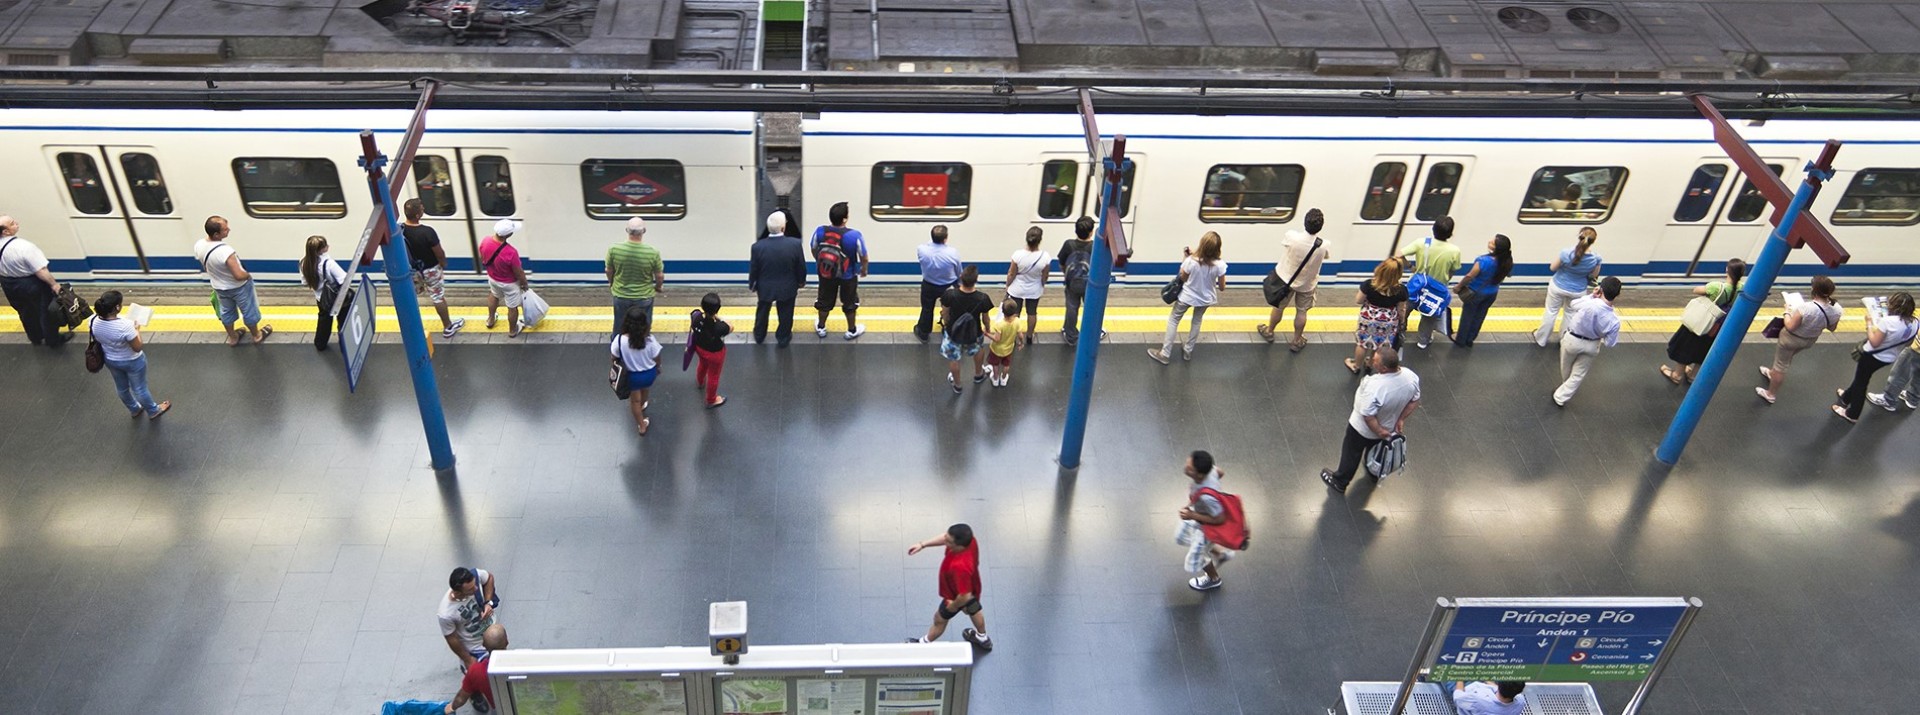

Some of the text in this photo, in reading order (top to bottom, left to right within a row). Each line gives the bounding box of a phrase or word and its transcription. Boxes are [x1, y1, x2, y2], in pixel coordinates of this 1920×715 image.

[351, 304, 362, 345] 6
[1500, 610, 1635, 626] Príncipe Pío
[1467, 639, 1480, 647] 6
[1580, 639, 1592, 647] 6
[1460, 652, 1474, 662] R
